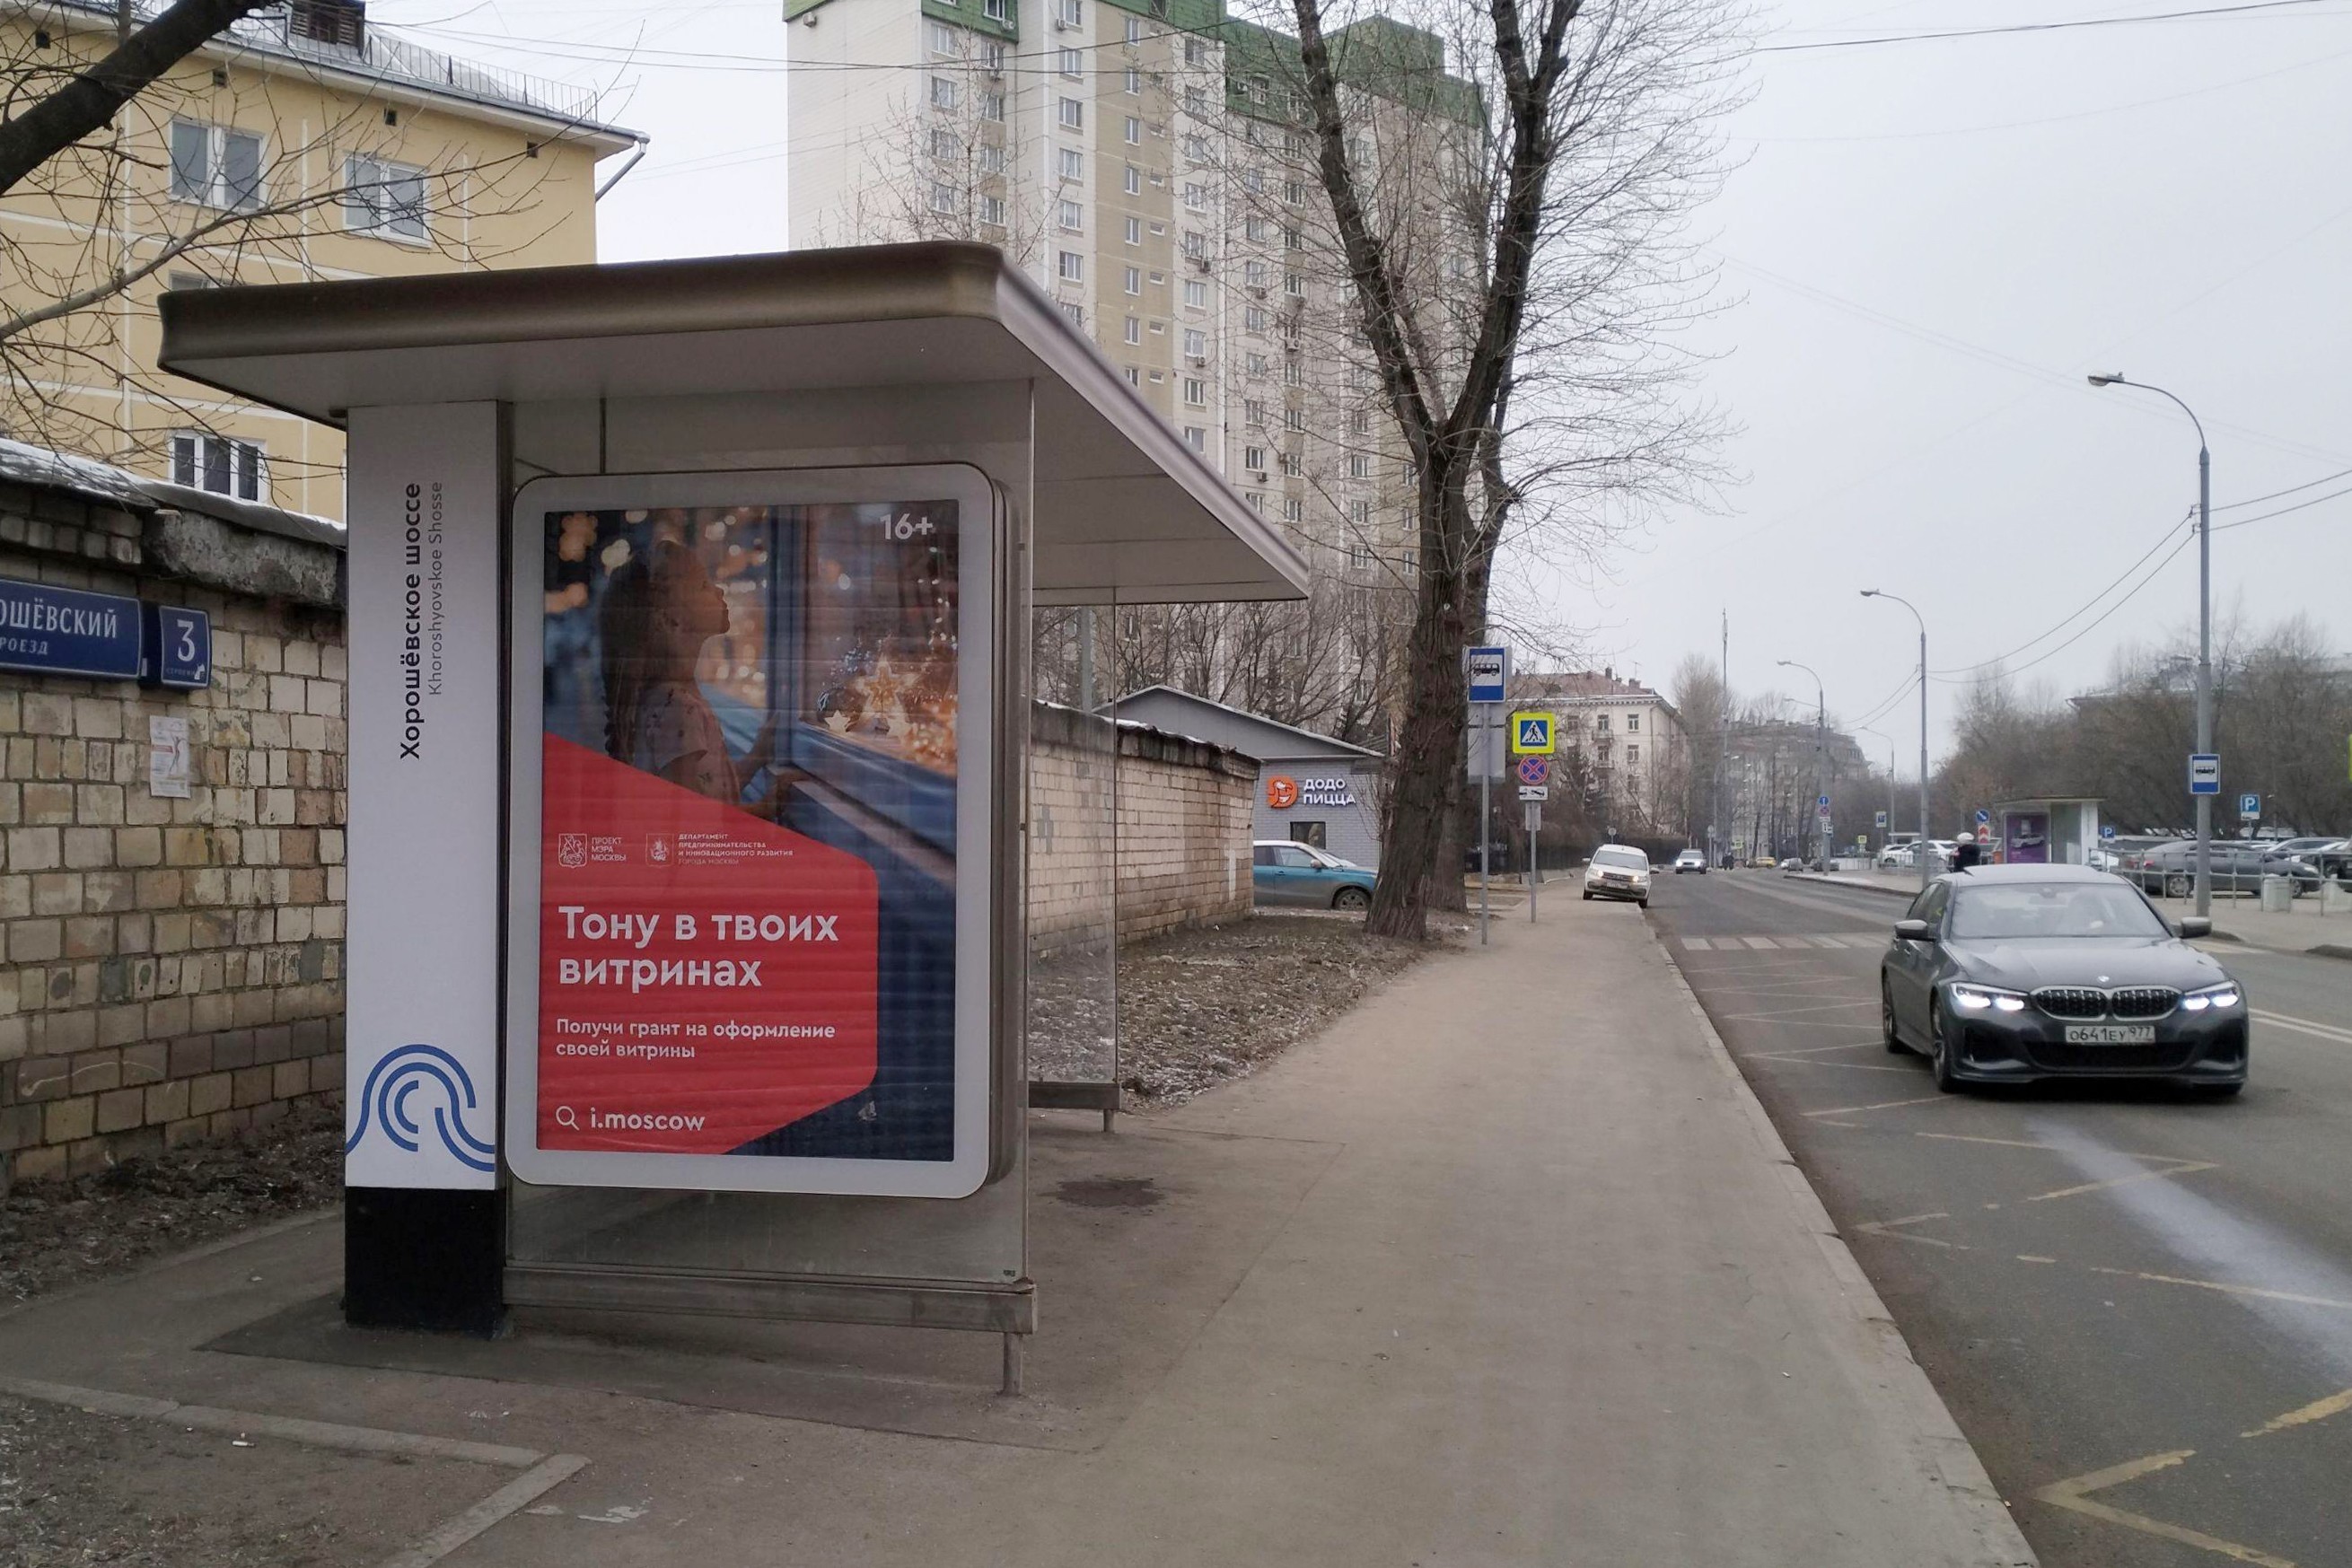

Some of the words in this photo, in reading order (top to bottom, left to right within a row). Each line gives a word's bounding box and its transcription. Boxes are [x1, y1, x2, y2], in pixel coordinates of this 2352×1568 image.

[406, 483, 421, 565] шоссе
[428, 482, 443, 544] Shosse
[880, 513, 934, 539] 16+
[428, 549, 445, 695] Khoroshyovskoe
[177, 619, 196, 661] 3
[400, 574, 425, 759] Хорошёвское
[1303, 778, 1346, 792] ДОДО
[1303, 793, 1356, 806] ПИЦЦА
[2244, 797, 2255, 810] P
[591, 845, 614, 854] МЭРА
[592, 837, 622, 845] ПРОЕКТ
[591, 854, 627, 863] МОСКВЫ
[558, 906, 661, 949] Тону
[675, 915, 698, 941] в
[711, 914, 839, 942] твоих
[558, 959, 762, 994] витринах
[557, 1018, 625, 1038] Получи
[629, 1023, 680, 1038] грант
[686, 1024, 708, 1037] на
[713, 1021, 836, 1041] оформление
[556, 1039, 610, 1056] своей
[616, 1044, 696, 1060] витрины
[590, 1107, 706, 1132] i.moscow
